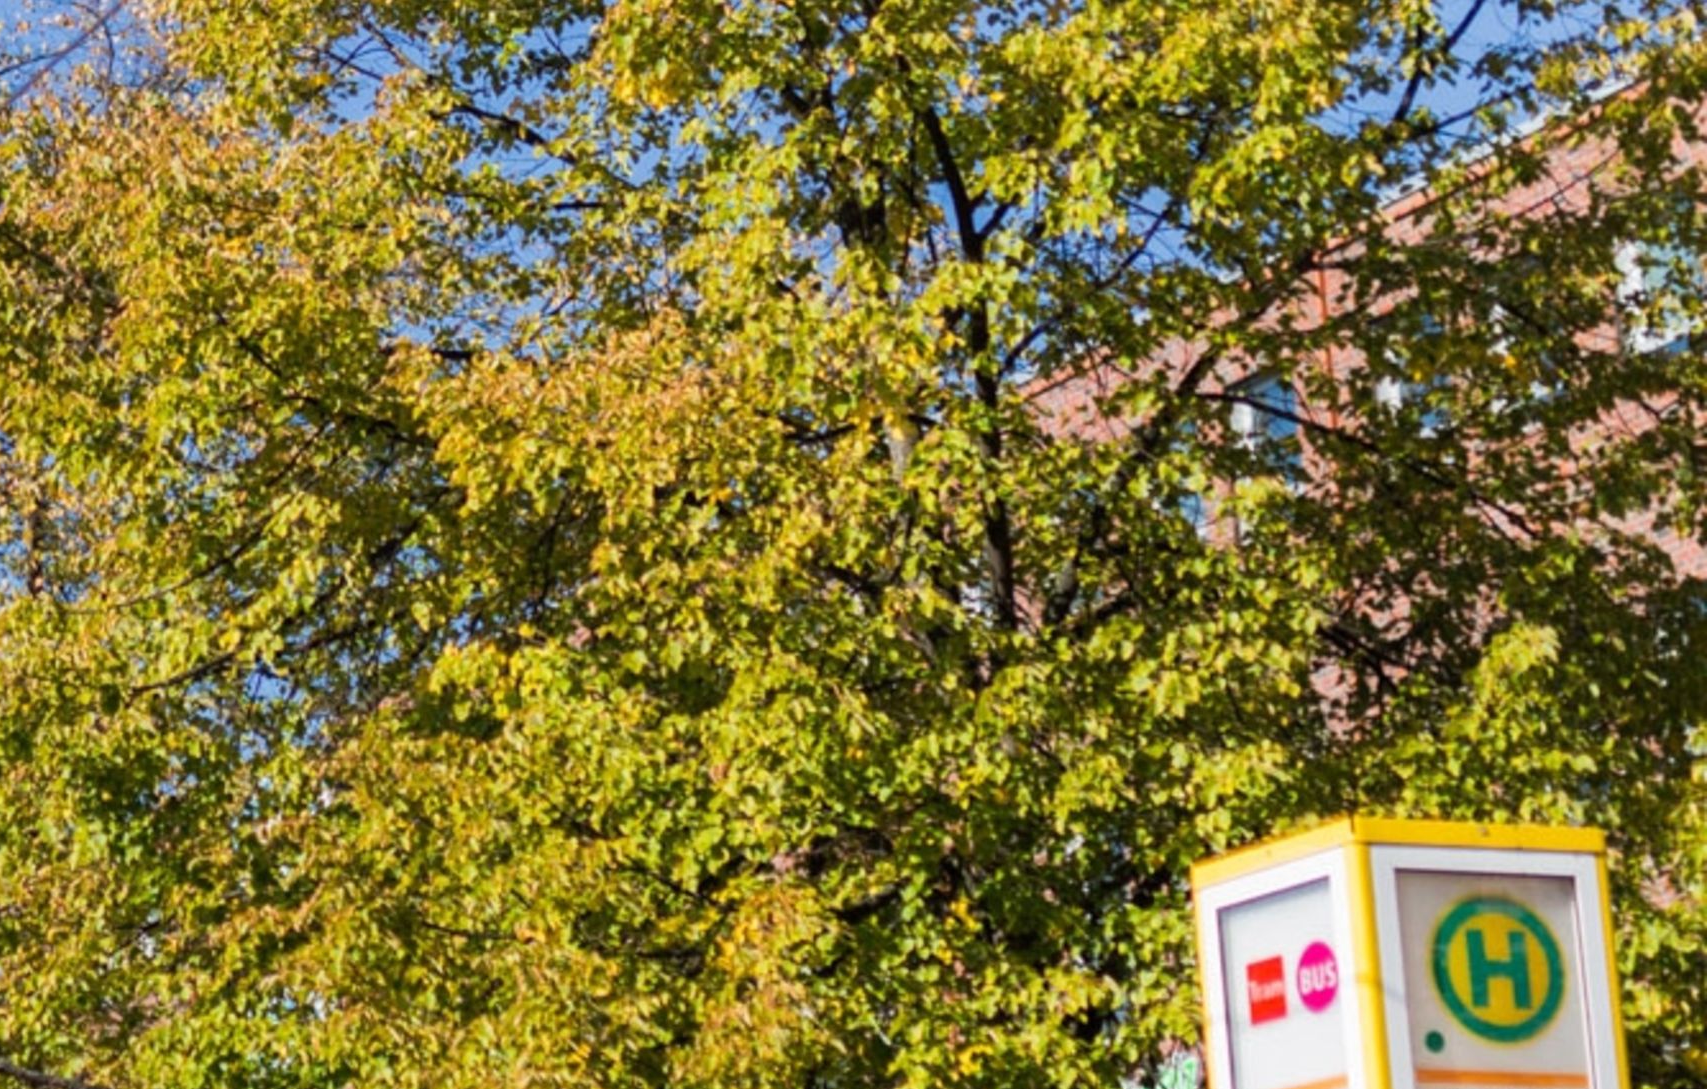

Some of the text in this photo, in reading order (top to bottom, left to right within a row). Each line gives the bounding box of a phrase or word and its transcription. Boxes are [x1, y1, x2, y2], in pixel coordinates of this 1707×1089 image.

[1298, 961, 1338, 994] BUS
[1466, 929, 1533, 1010] H
[1249, 979, 1285, 1003] Tram
